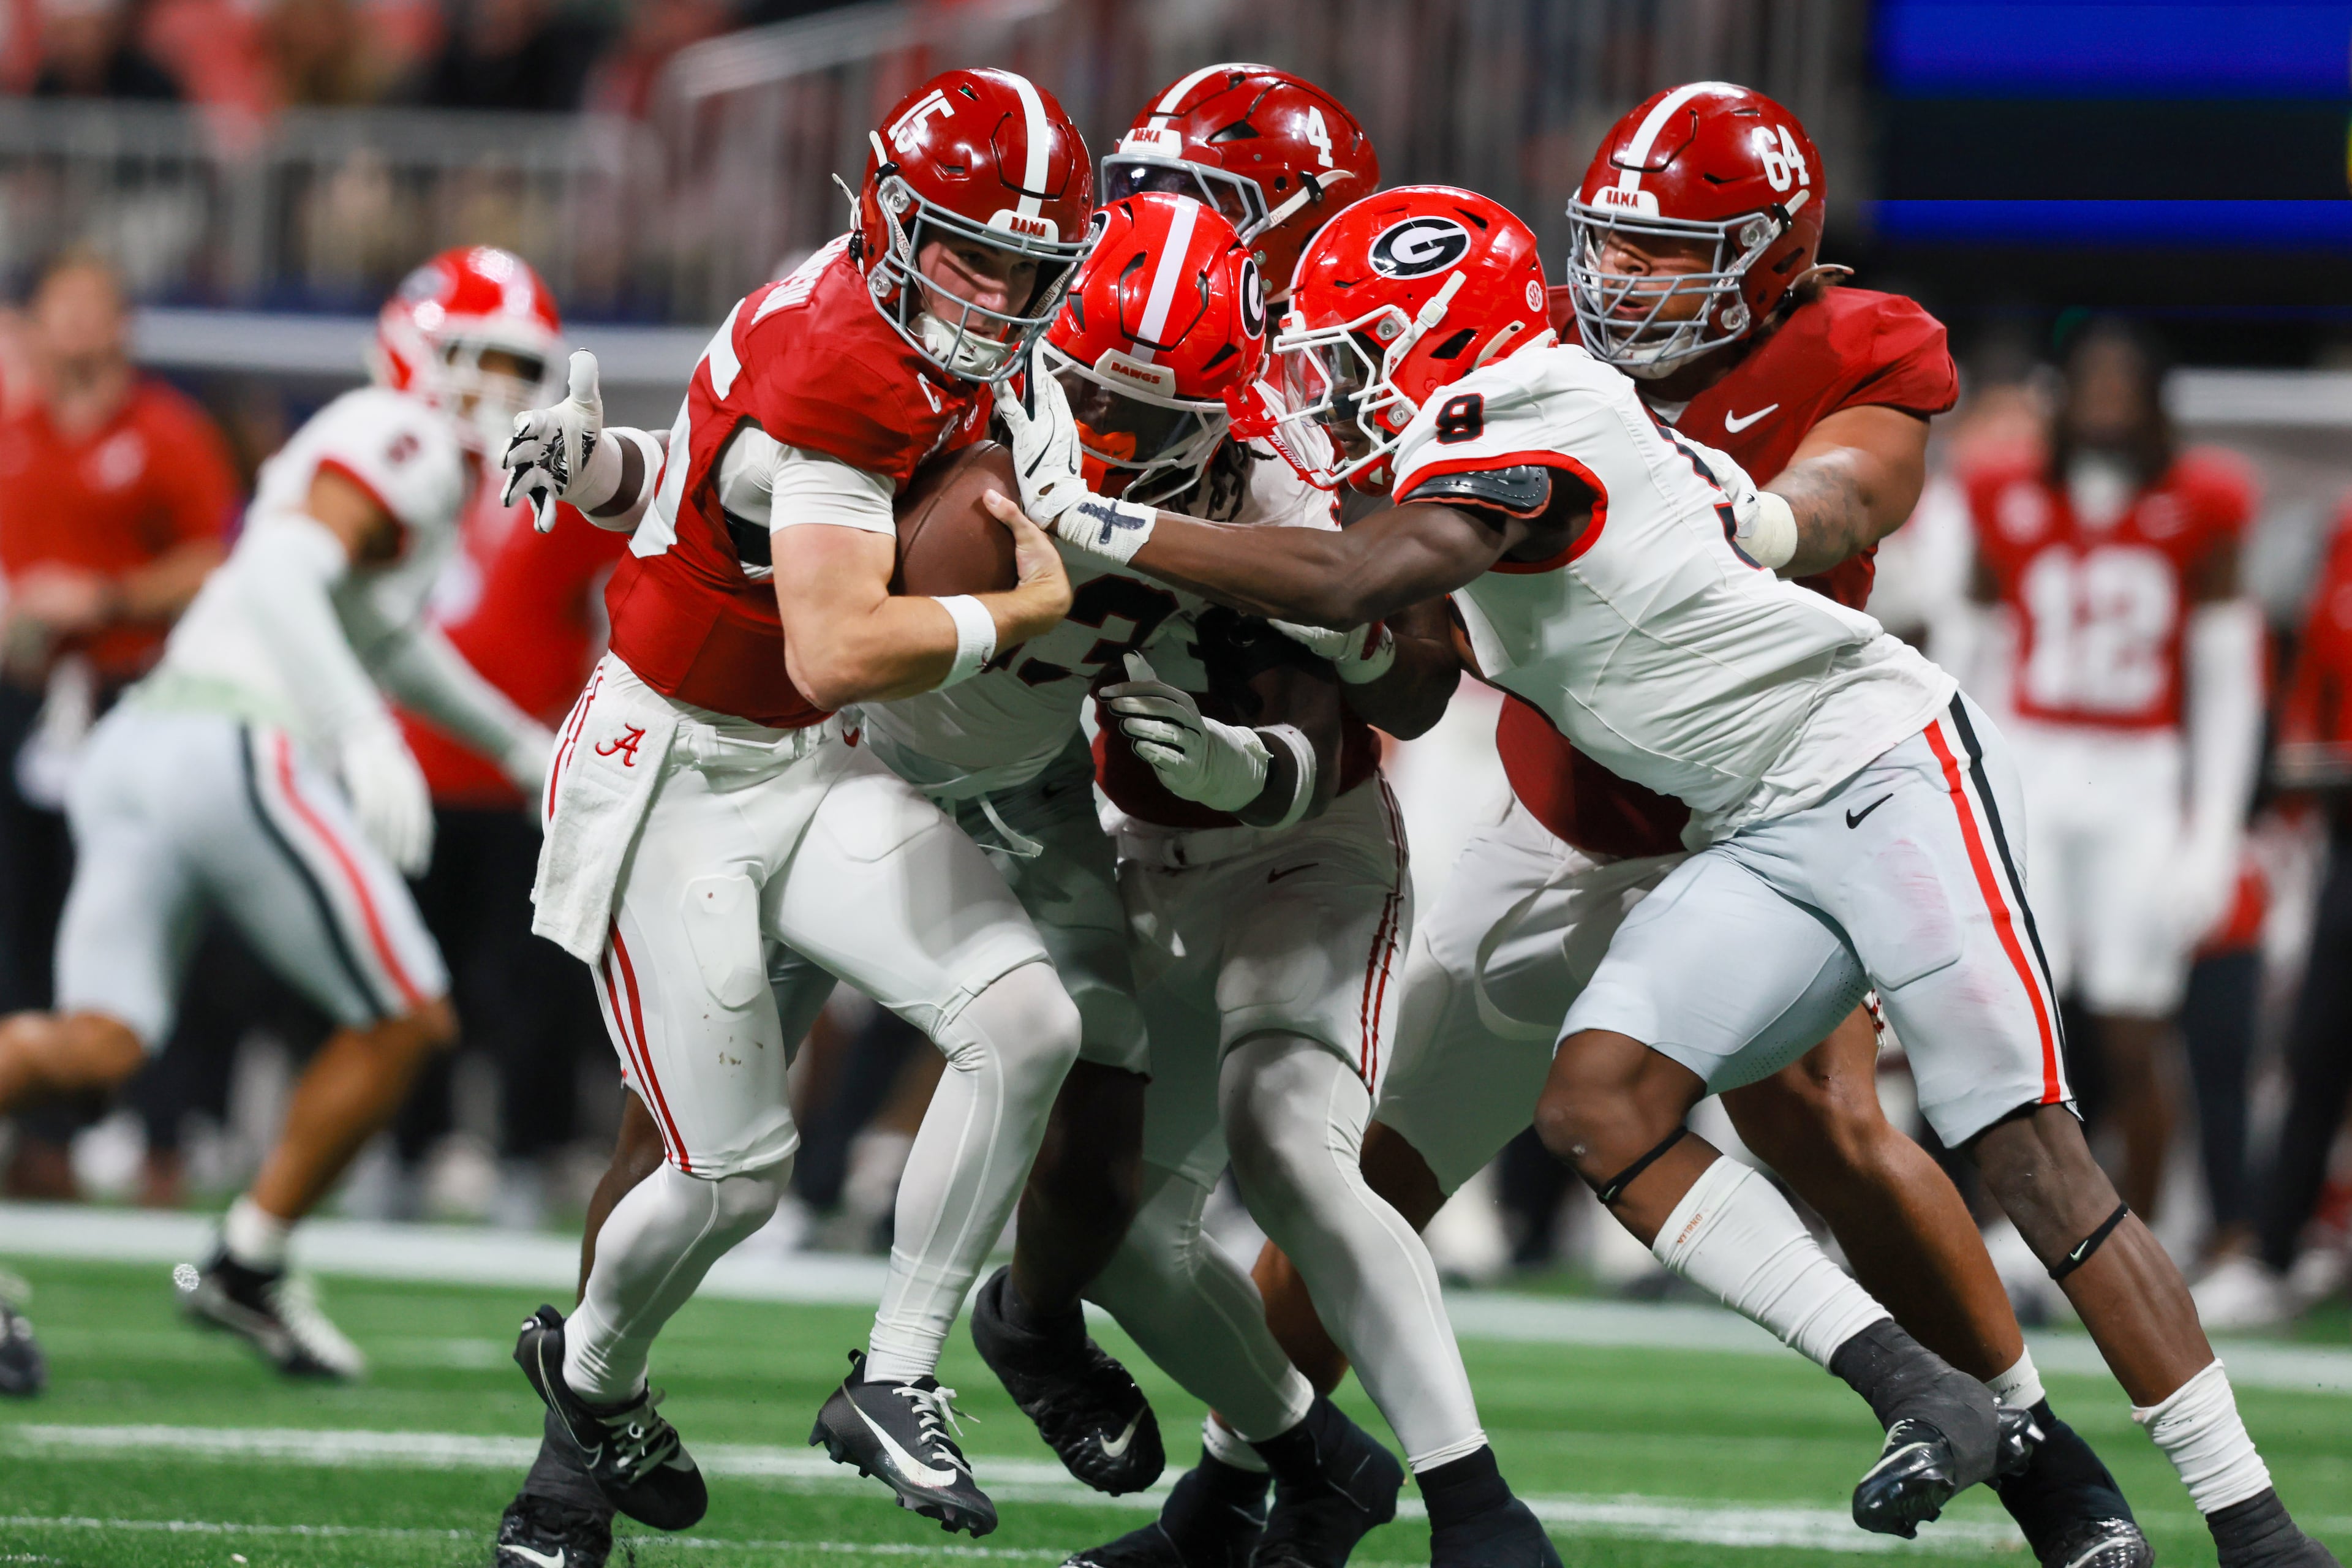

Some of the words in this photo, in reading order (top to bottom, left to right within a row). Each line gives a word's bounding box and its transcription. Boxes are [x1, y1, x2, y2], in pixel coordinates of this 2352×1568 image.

[888, 88, 955, 154] 15
[1132, 128, 1161, 143] BAMA
[1305, 105, 1333, 168] 4
[1752, 124, 1810, 192] 64
[1606, 190, 1638, 208] BAMA
[1009, 216, 1046, 237] BAMA
[1373, 219, 1467, 276] G
[1110, 361, 1162, 385] DAWGS
[1436, 393, 1484, 445] 8
[1267, 434, 1304, 469] NXTRND
[2023, 544, 2179, 712] 12
